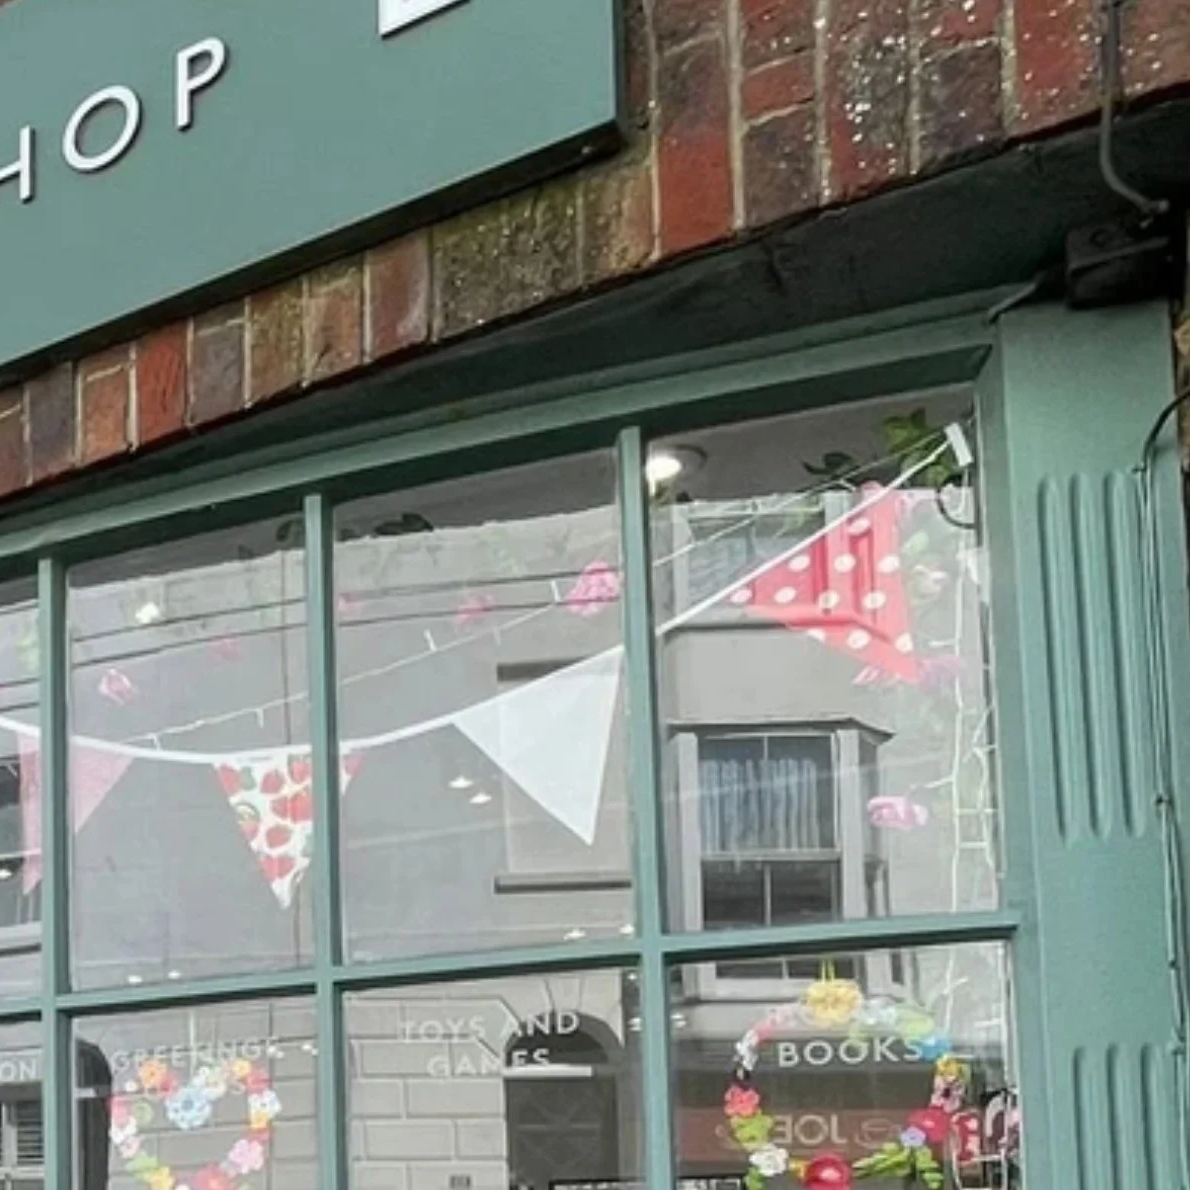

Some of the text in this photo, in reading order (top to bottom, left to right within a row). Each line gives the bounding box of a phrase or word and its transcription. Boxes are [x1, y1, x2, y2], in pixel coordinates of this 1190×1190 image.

[400, 1011, 579, 1044] TOYS AND
[778, 1036, 922, 1068] BOOKS
